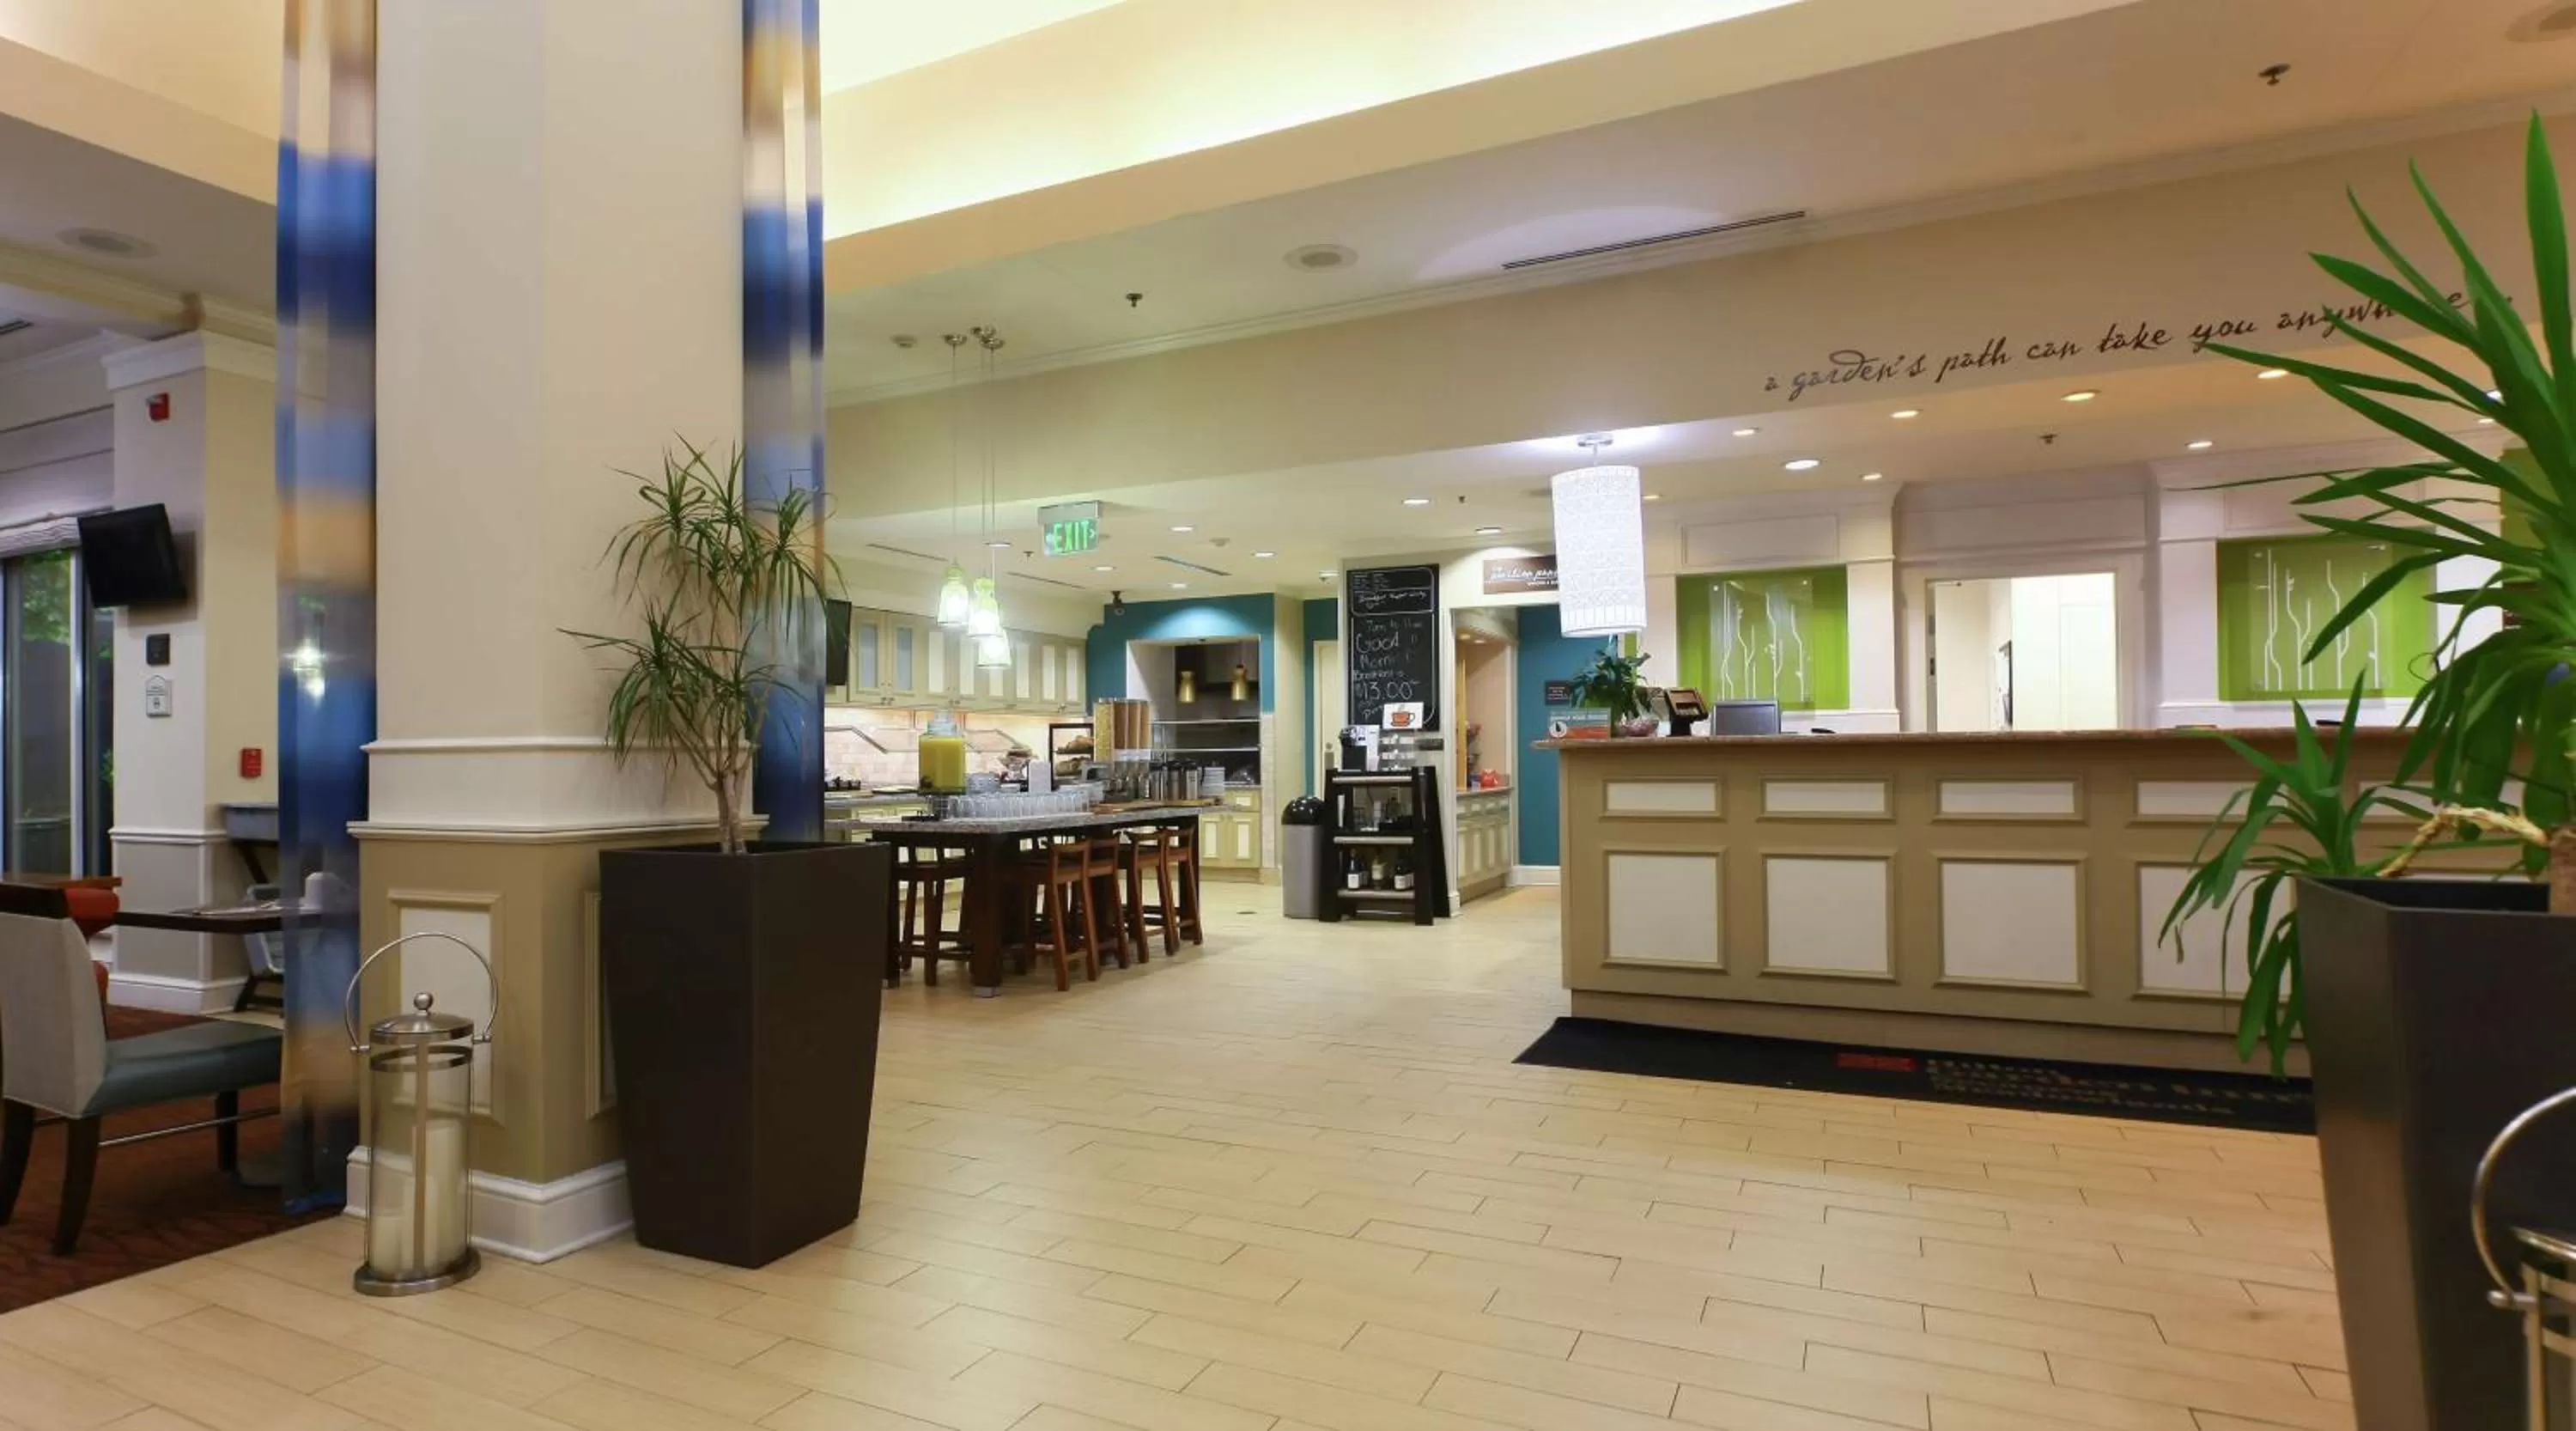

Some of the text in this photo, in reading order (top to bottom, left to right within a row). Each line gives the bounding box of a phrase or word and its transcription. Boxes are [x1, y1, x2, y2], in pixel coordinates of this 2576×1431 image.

[1764, 376, 1780, 391] a
[1788, 350, 1927, 401] garden's
[1934, 336, 2013, 383] path
[2026, 340, 2081, 361] can
[2097, 321, 2172, 353] take
[2188, 318, 2257, 355] you
[1054, 521, 1089, 551] EXIT
[1356, 630, 1400, 655] Good
